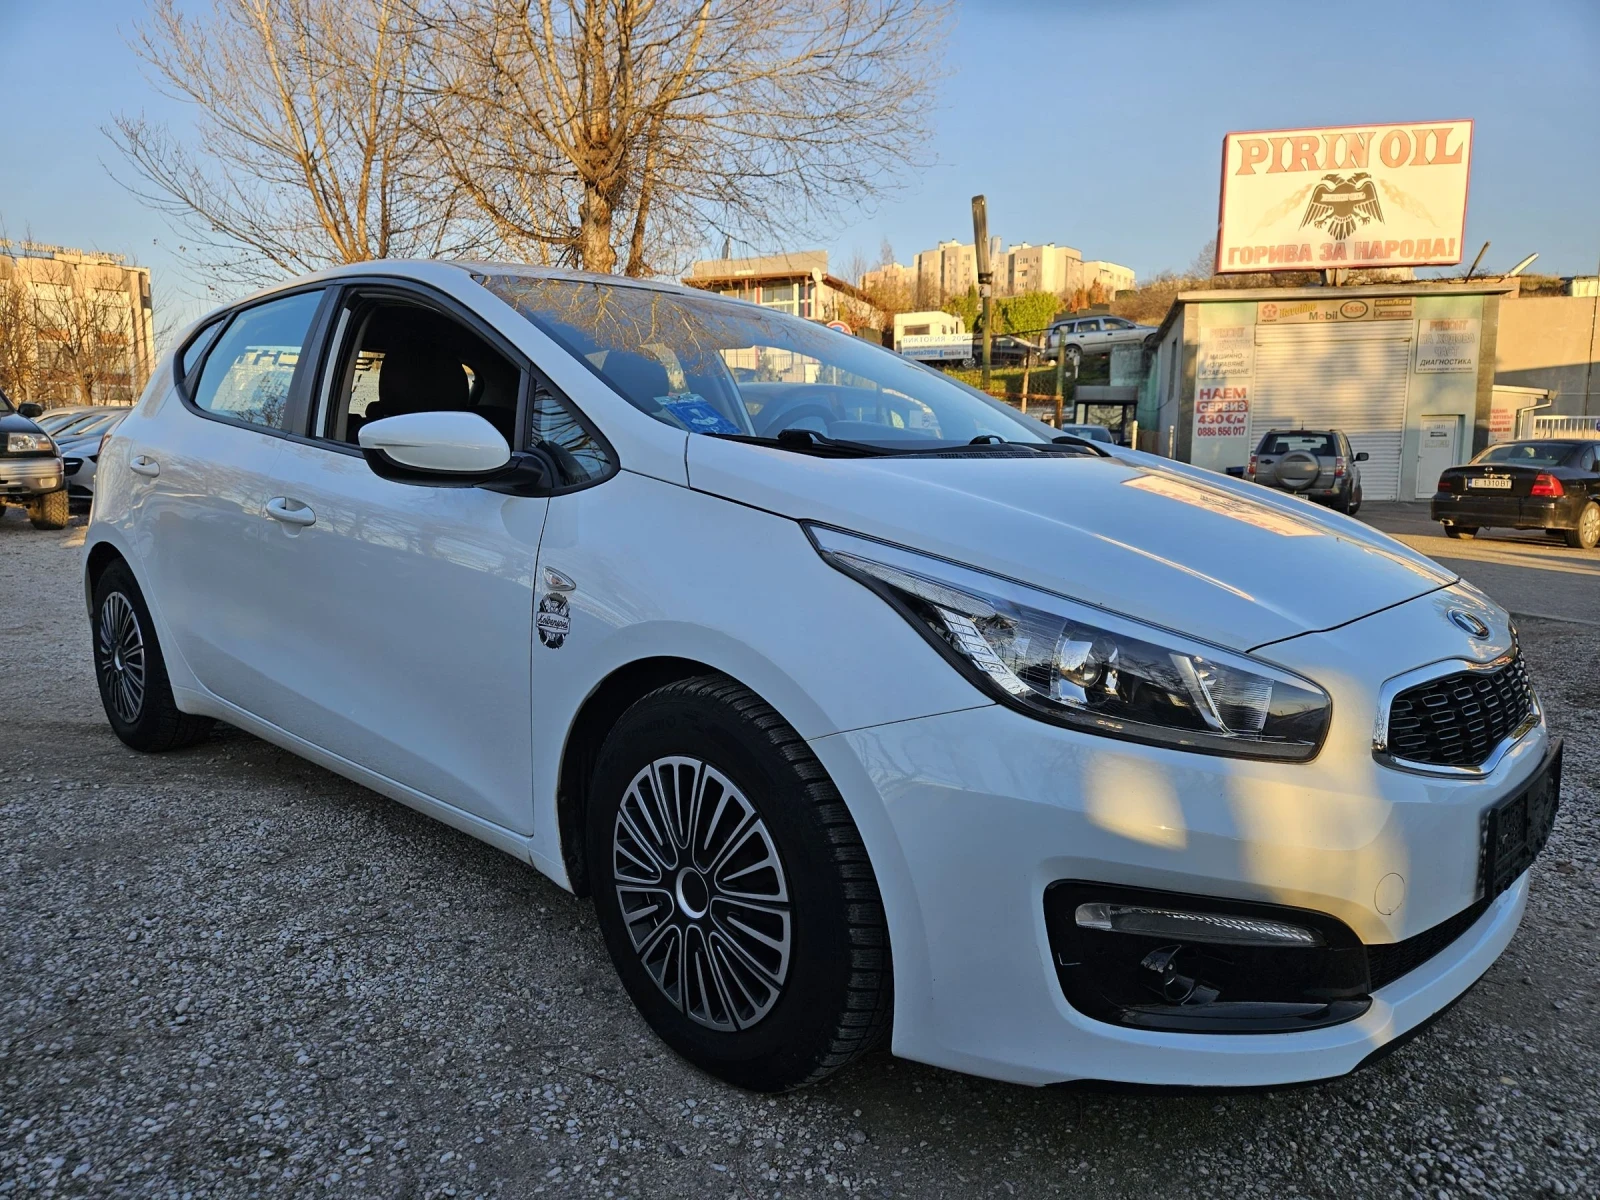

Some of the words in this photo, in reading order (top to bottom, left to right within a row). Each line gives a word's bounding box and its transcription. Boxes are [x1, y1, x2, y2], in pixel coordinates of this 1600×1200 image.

[1235, 131, 1376, 175] PIRIN
[1379, 127, 1463, 168] OIL
[1227, 243, 1313, 265] ГОРИВА
[1319, 242, 1348, 261] ЗА
[1354, 237, 1456, 260] НАРОДА!
[1344, 305, 1365, 314] Esso
[1308, 310, 1338, 321] Mobil
[1436, 333, 1475, 345] ХОДОВА
[1419, 358, 1472, 366] ДИАГНОСТИКА
[1199, 387, 1247, 399] НАЕМ
[1199, 401, 1247, 412] СЕРВИЗ
[1233, 426, 1246, 436] 017
